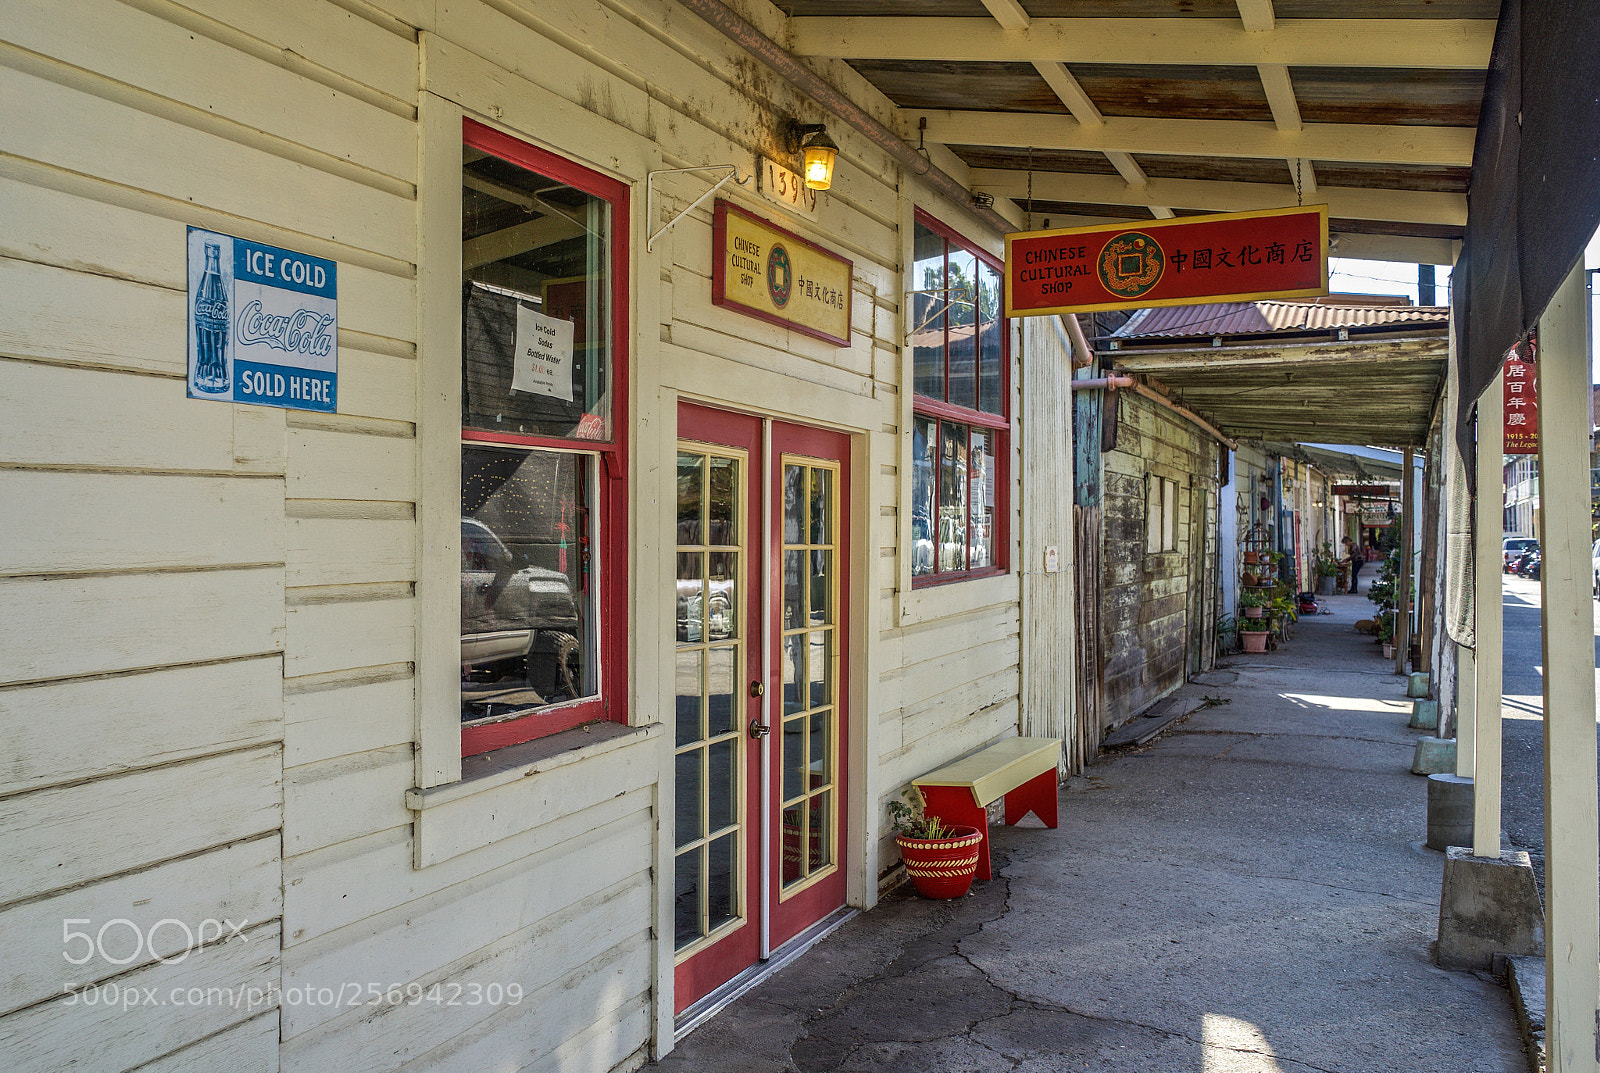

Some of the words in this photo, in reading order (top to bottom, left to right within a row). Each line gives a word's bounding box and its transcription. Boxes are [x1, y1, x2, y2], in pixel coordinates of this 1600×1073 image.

[734, 236, 760, 258] CHINESE
[1025, 246, 1087, 265] CHINESE
[1169, 239, 1314, 274] 中國文化商店
[246, 248, 275, 278] ICE
[280, 258, 326, 289] COLD
[731, 254, 762, 275] CULTURAL
[1020, 264, 1092, 282] CULTURAL
[740, 273, 754, 288] SHOP
[1041, 281, 1073, 295] SHOP
[798, 274, 844, 310] 中國文化商店
[535, 322, 543, 332] Ice
[543, 326, 556, 336] Cold
[537, 337, 553, 349] Sodas
[526, 348, 545, 361] Bottled
[545, 353, 562, 364] Water
[242, 369, 286, 397] SOLD
[290, 376, 331, 402] HERE
